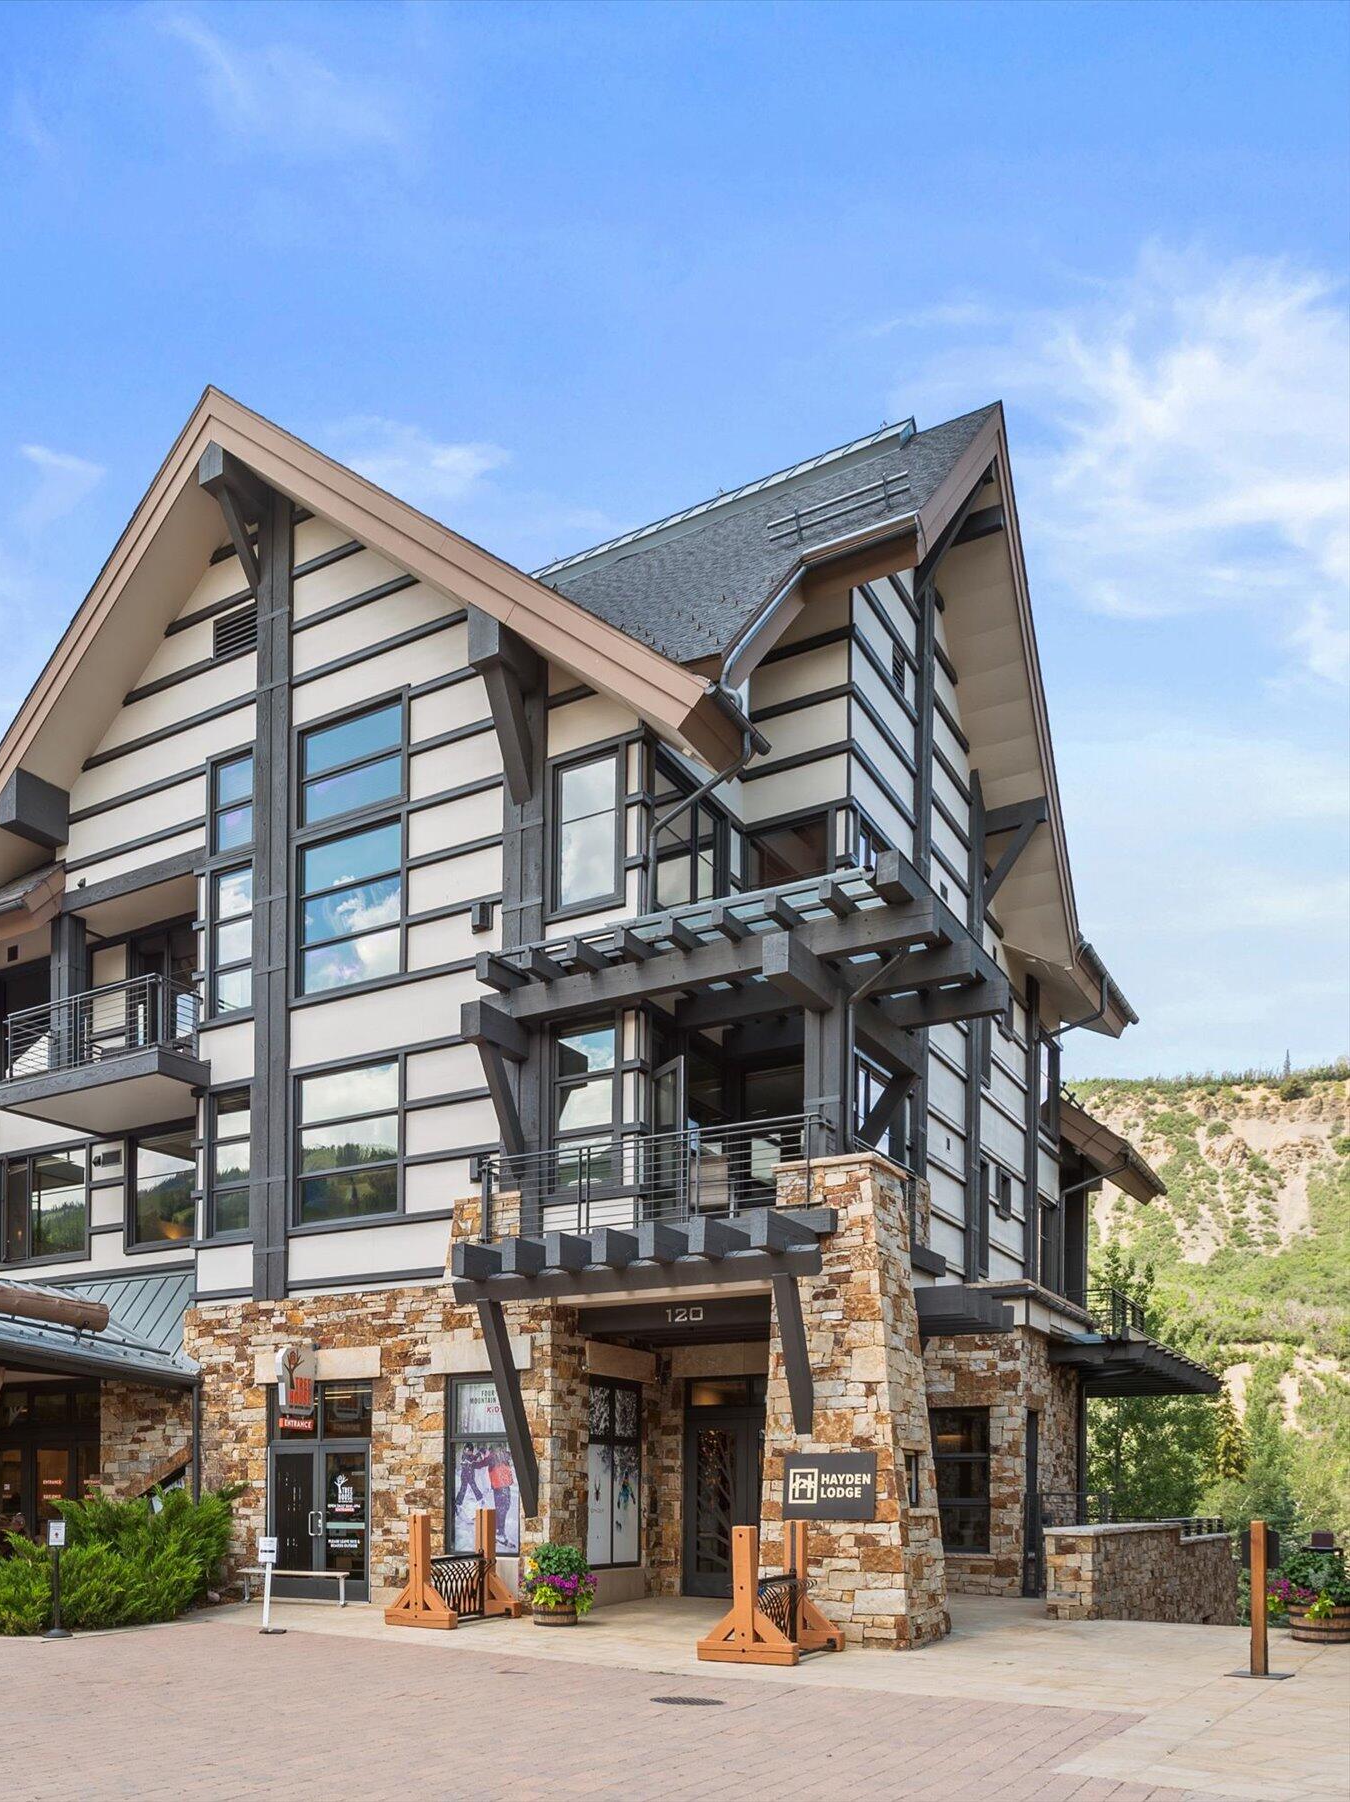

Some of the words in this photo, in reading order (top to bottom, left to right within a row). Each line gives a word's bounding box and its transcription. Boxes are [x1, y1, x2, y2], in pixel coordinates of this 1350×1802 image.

[666, 1307, 704, 1322] 120
[284, 1420, 312, 1429] ENTRANCE
[821, 1473, 871, 1485] HAYDEN
[820, 1487, 862, 1498] LODGE
